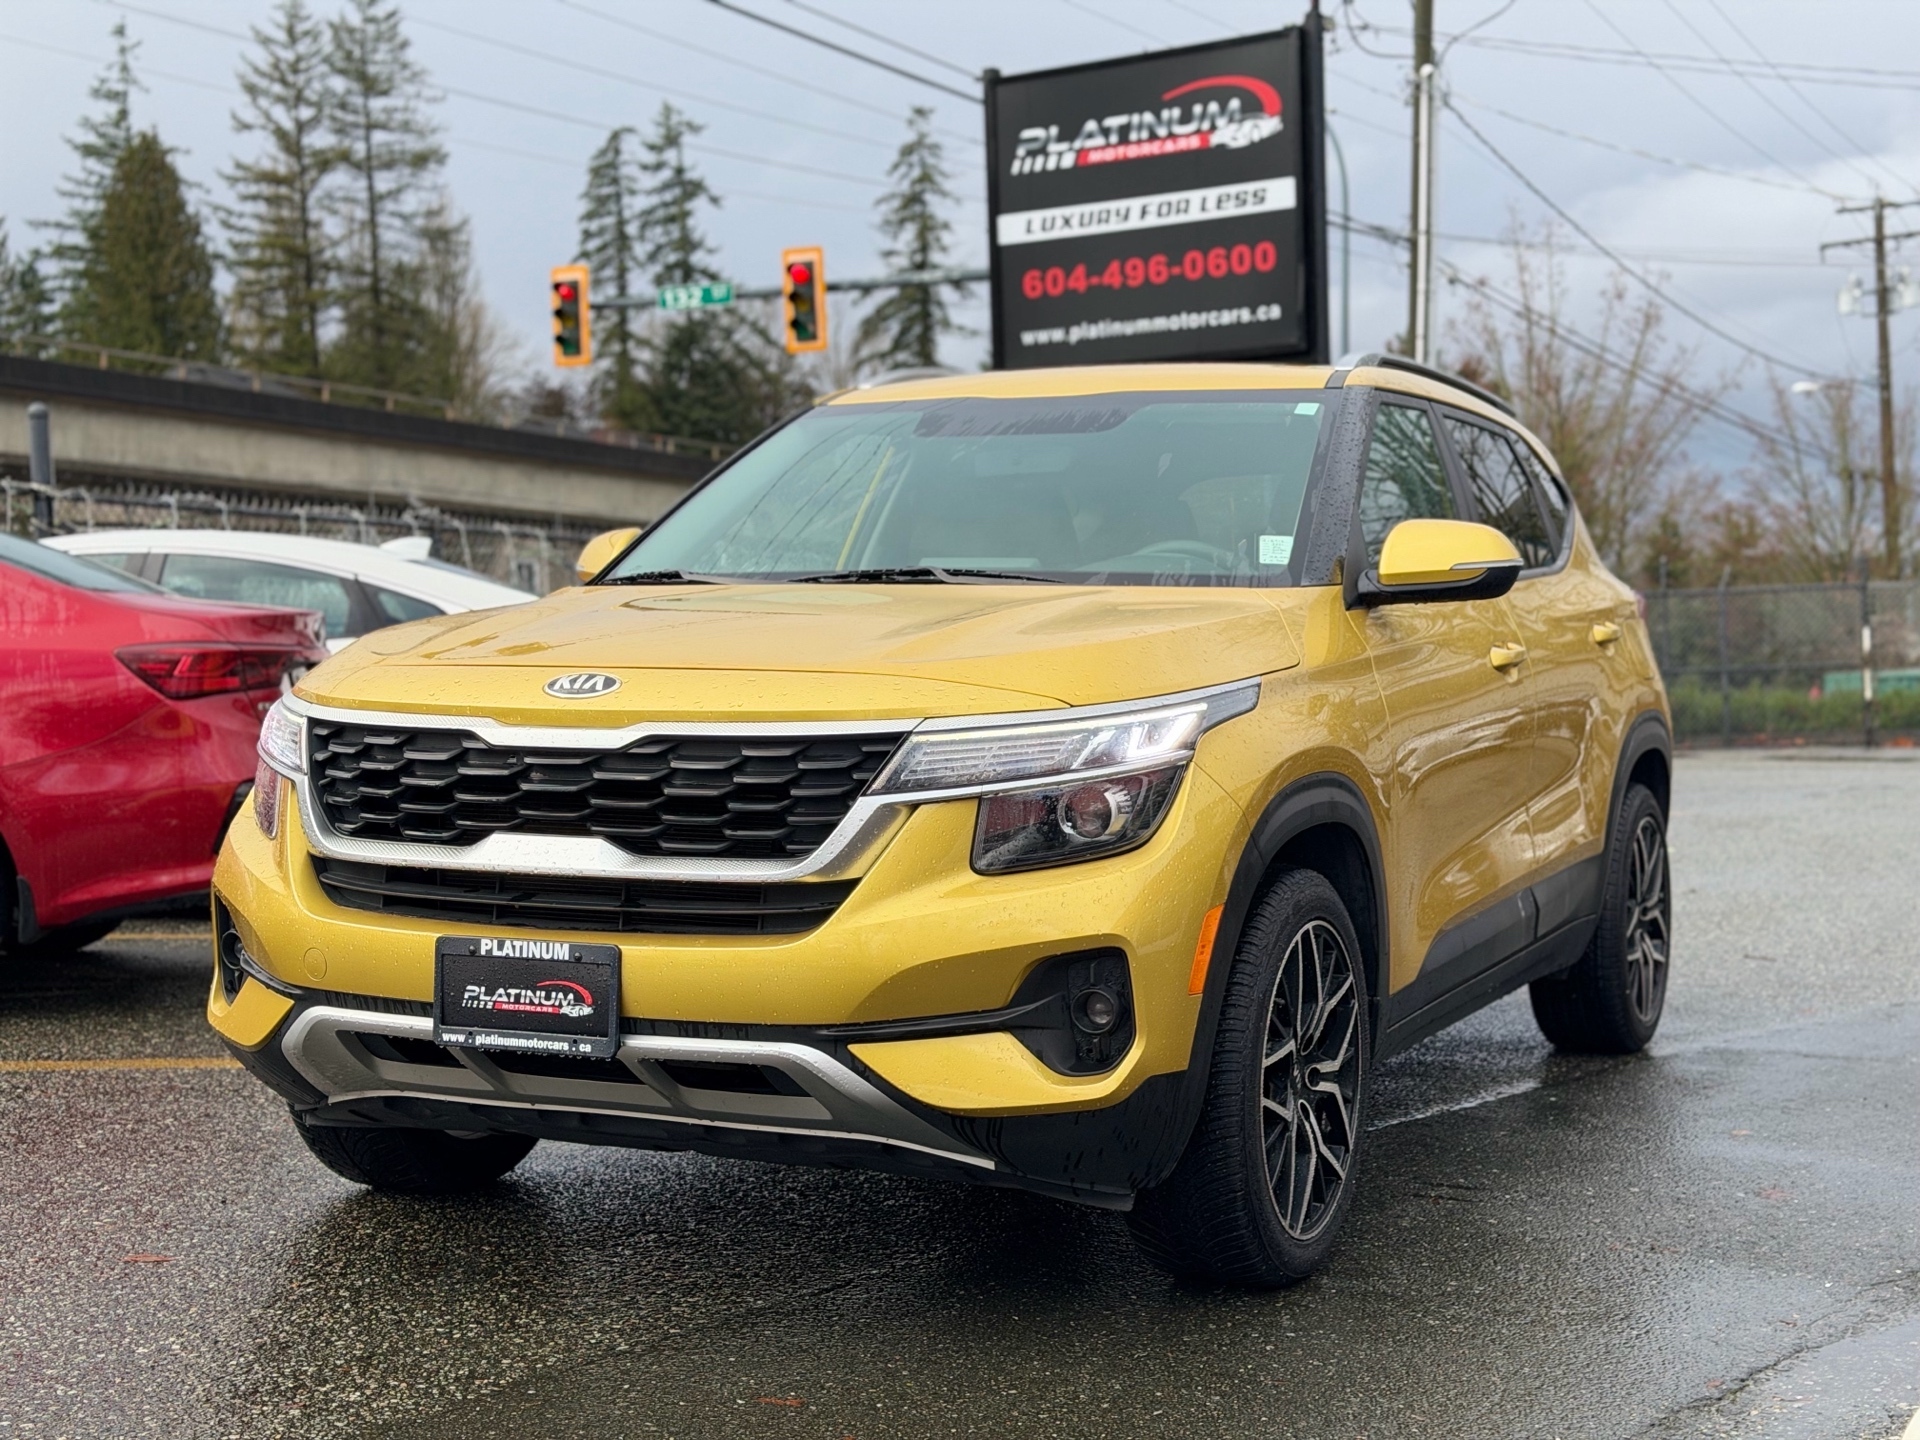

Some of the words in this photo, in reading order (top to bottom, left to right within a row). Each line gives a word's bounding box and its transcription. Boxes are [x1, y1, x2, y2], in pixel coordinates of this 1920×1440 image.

[1015, 97, 1242, 158] PLATINUM
[1086, 133, 1202, 165] MOTORCARS
[1025, 206, 1131, 234] LUXURY
[1139, 198, 1190, 220] FOR
[1021, 240, 1277, 300] 604-496-0600
[1020, 303, 1282, 346] www.platinummotorcars.ca
[553, 674, 606, 691] KIA
[481, 939, 569, 960] PLATINUM
[463, 985, 574, 1006] PLATINUM
[501, 1003, 553, 1013] MOTORCARS
